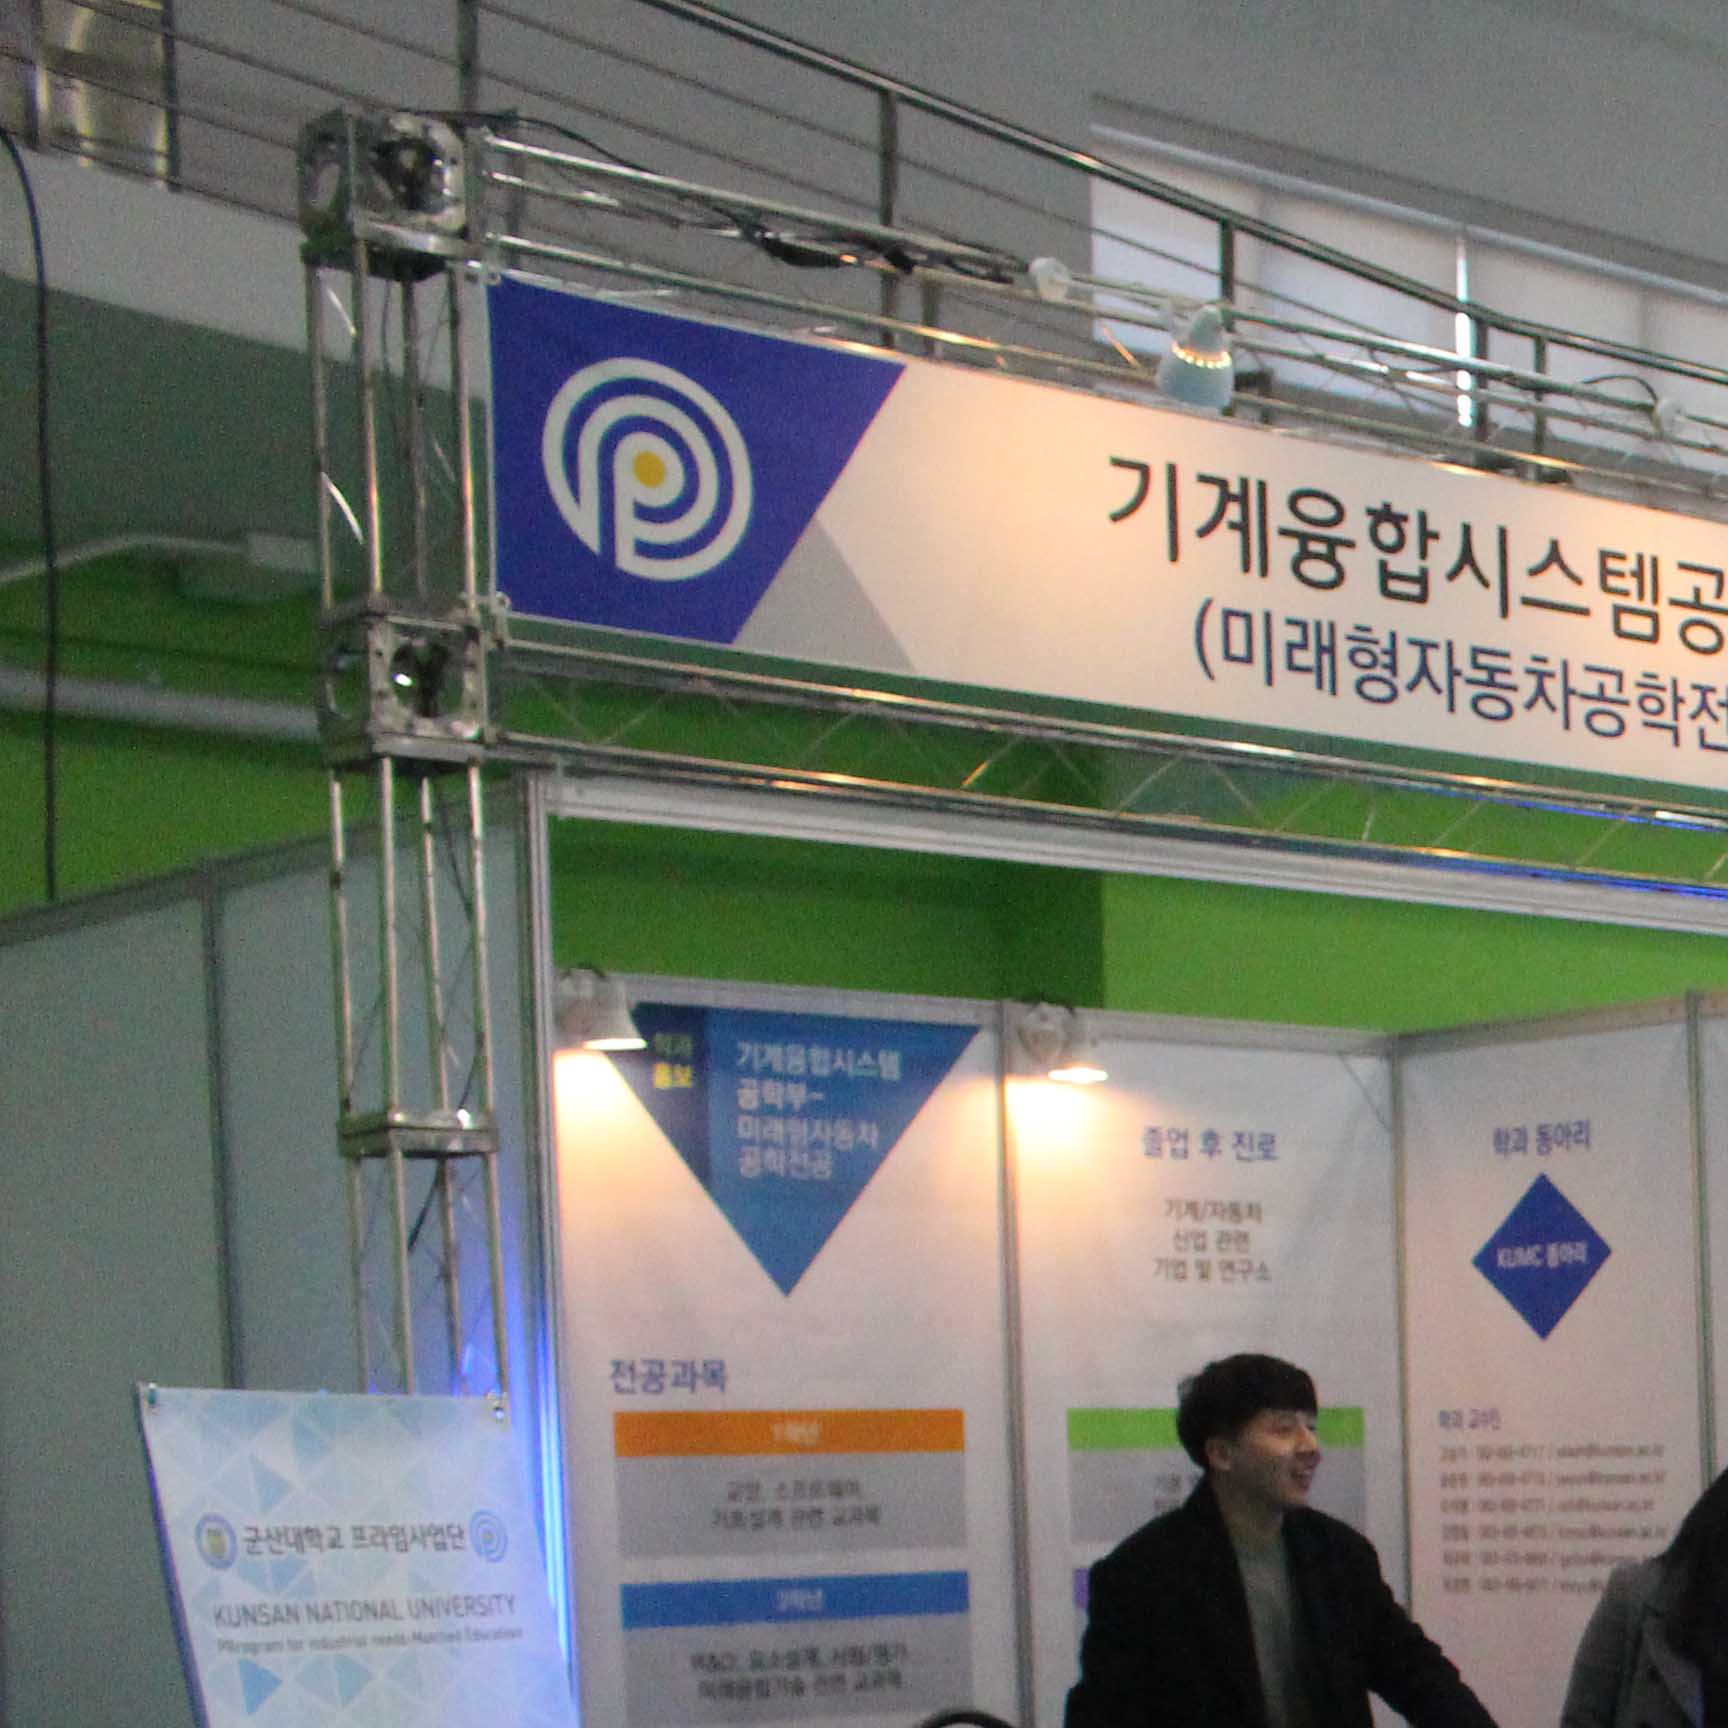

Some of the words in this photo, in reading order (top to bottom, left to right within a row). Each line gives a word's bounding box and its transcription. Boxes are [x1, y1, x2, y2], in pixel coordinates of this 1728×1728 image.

[1232, 1130, 1280, 1162] 진로
[1536, 1118, 1591, 1156] 동아리
[609, 1358, 728, 1394] 전공과목
[242, 1525, 345, 1557] 군산대학교
[351, 1523, 466, 1553] 프라임사업단
[213, 1603, 301, 1628] KUNSAN
[304, 1599, 403, 1624] NATIONAL
[406, 1594, 516, 1620] UNIVERSITY
